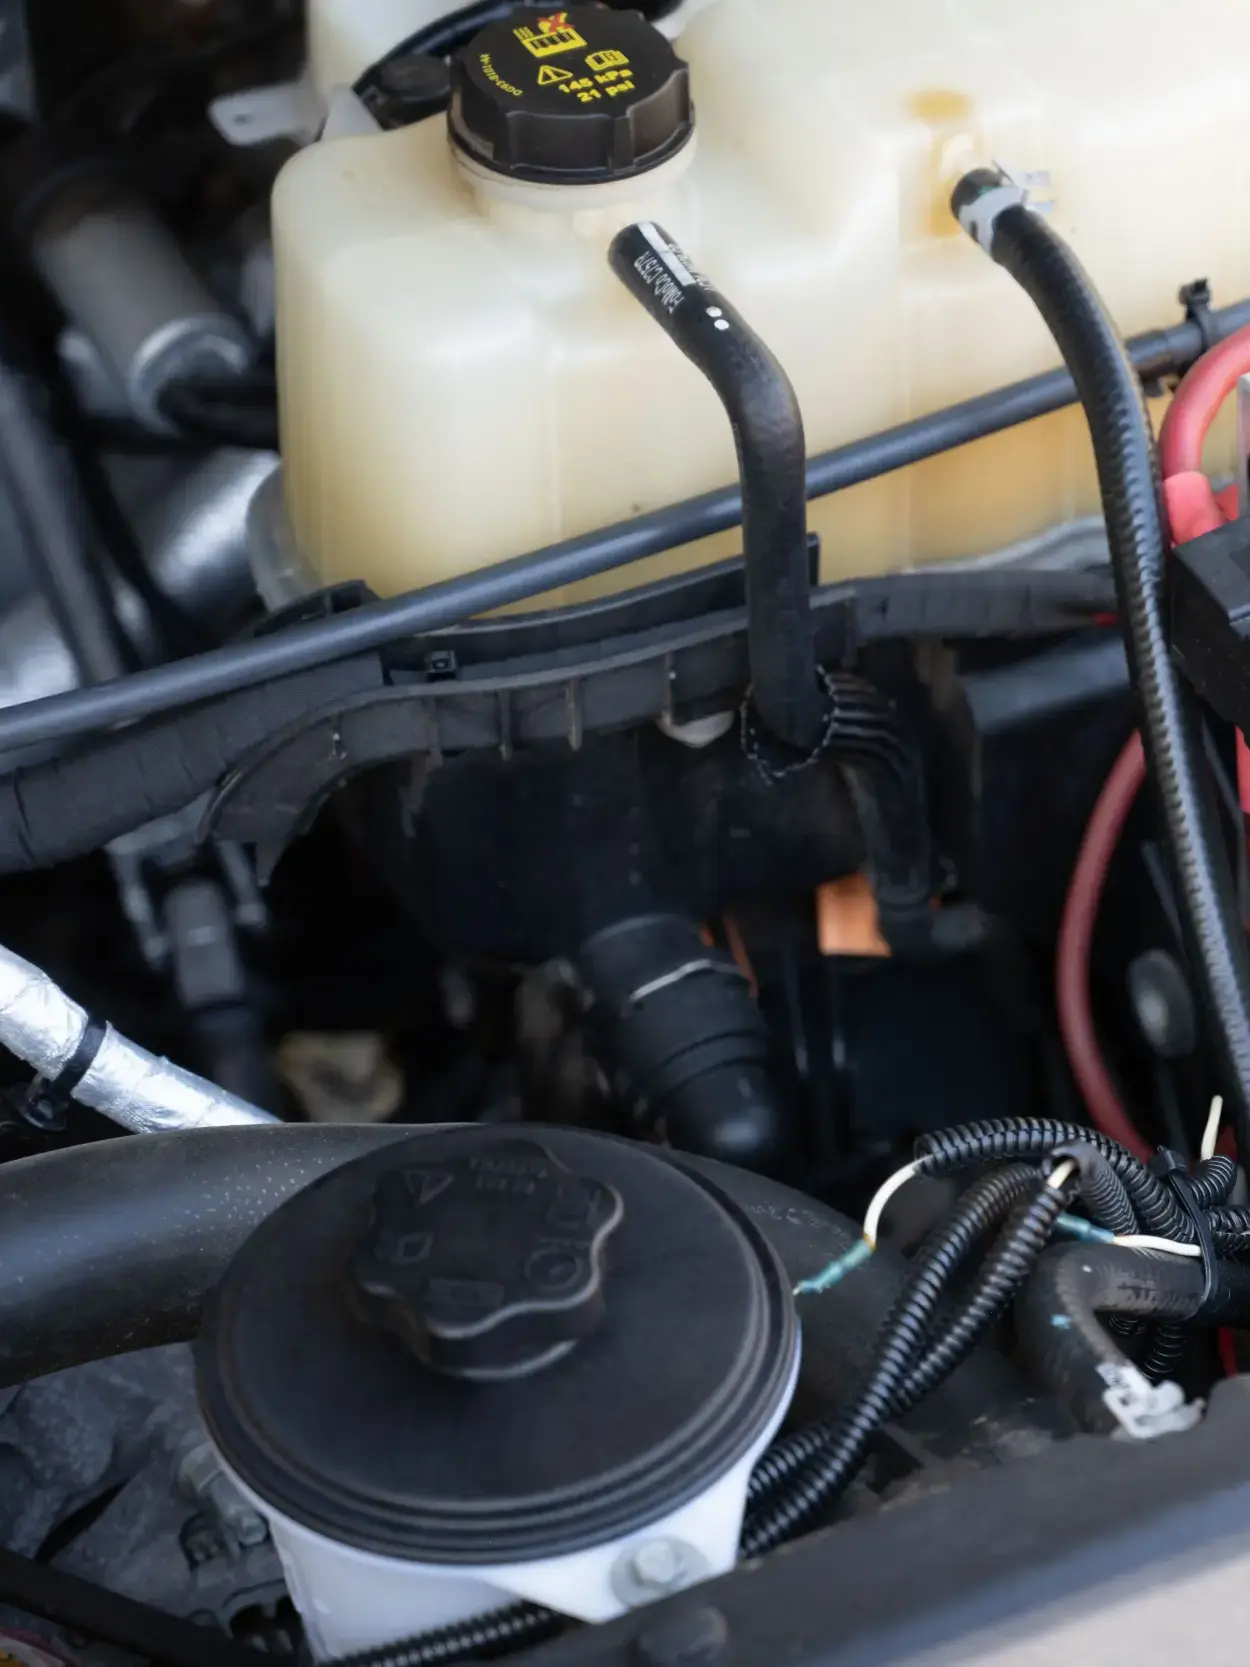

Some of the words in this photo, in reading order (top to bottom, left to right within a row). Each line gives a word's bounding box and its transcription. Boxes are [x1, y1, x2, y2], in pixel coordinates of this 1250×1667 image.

[558, 77, 594, 94] 145
[594, 69, 634, 84] kPa
[576, 89, 602, 103] 21
[604, 80, 636, 98] psi
